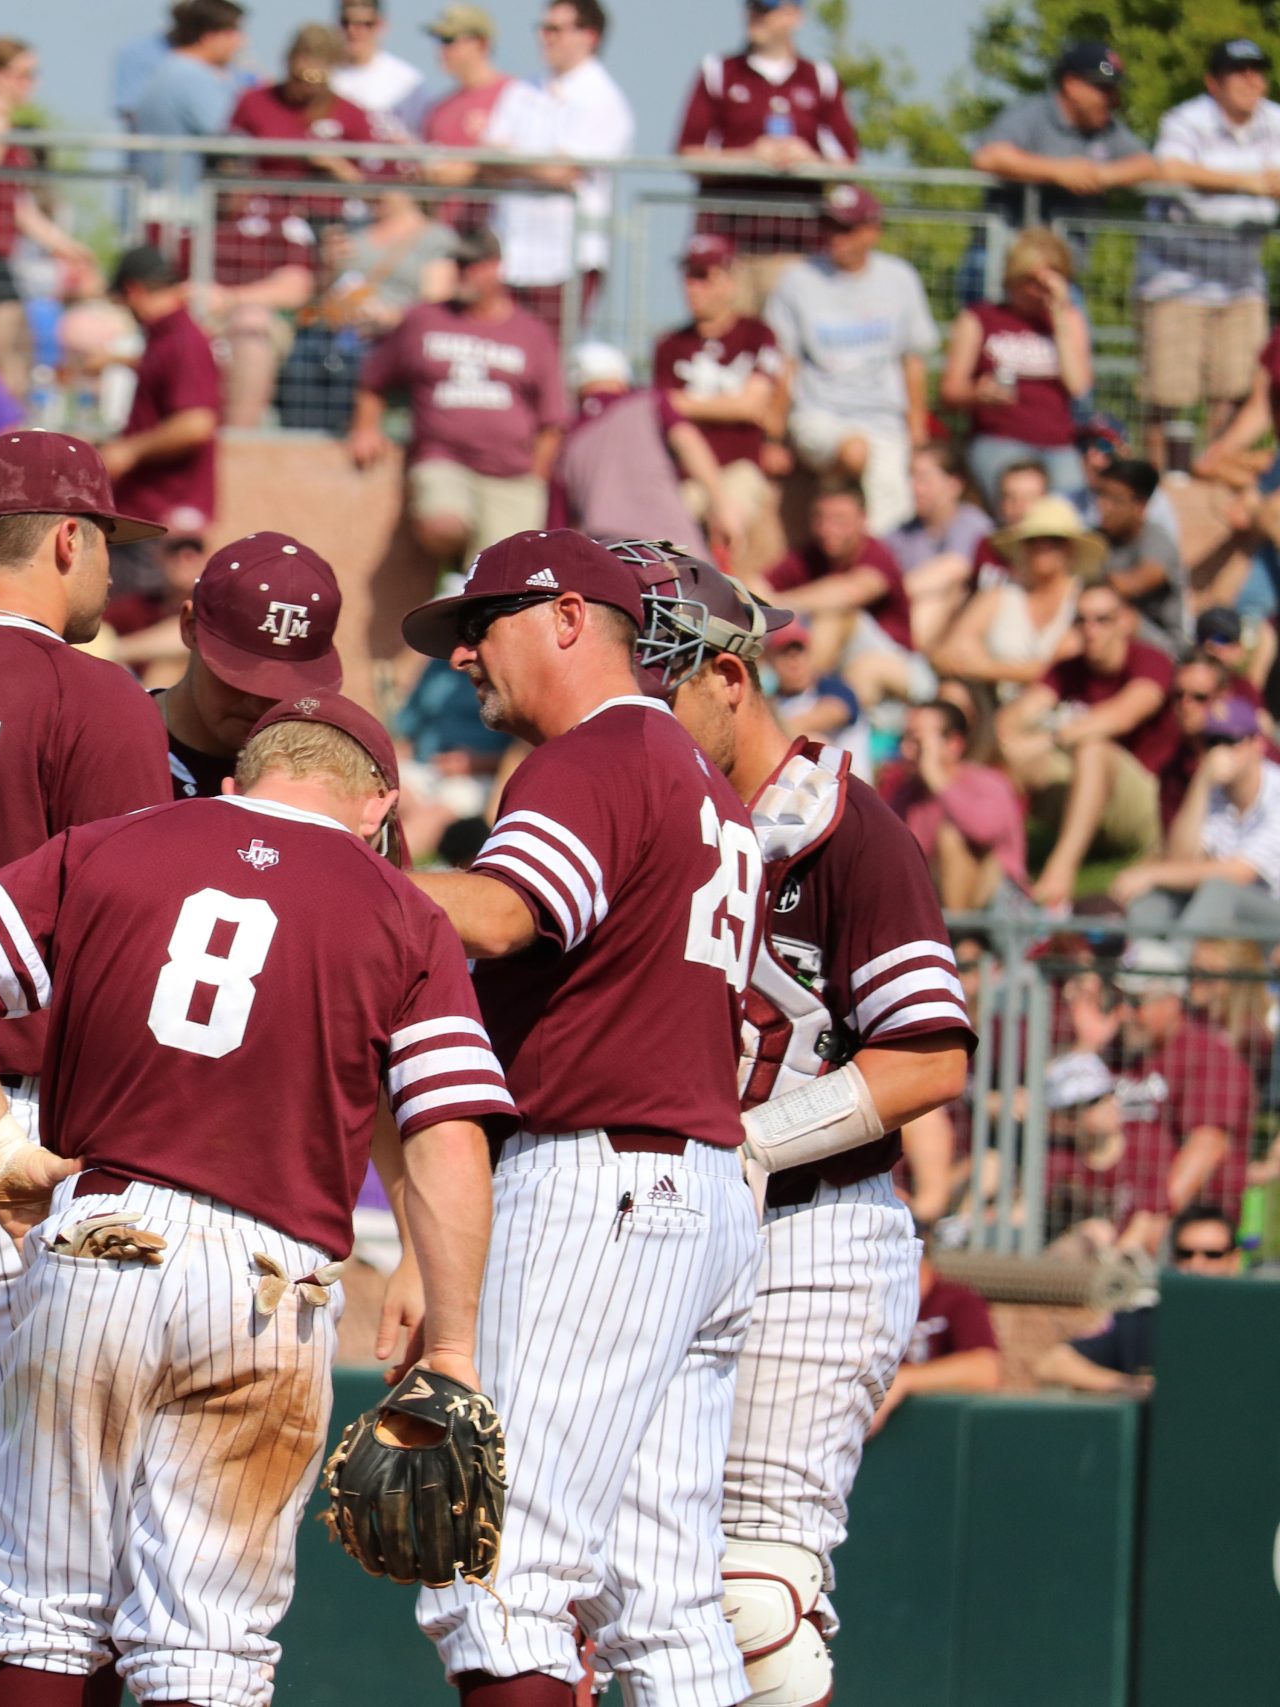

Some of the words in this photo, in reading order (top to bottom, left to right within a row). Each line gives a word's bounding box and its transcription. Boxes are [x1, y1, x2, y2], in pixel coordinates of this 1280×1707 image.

[525, 579, 559, 588] adidas
[258, 601, 311, 646] ATM
[684, 796, 762, 993] 29
[147, 887, 279, 1059] 8
[648, 1190, 682, 1203] adidas
